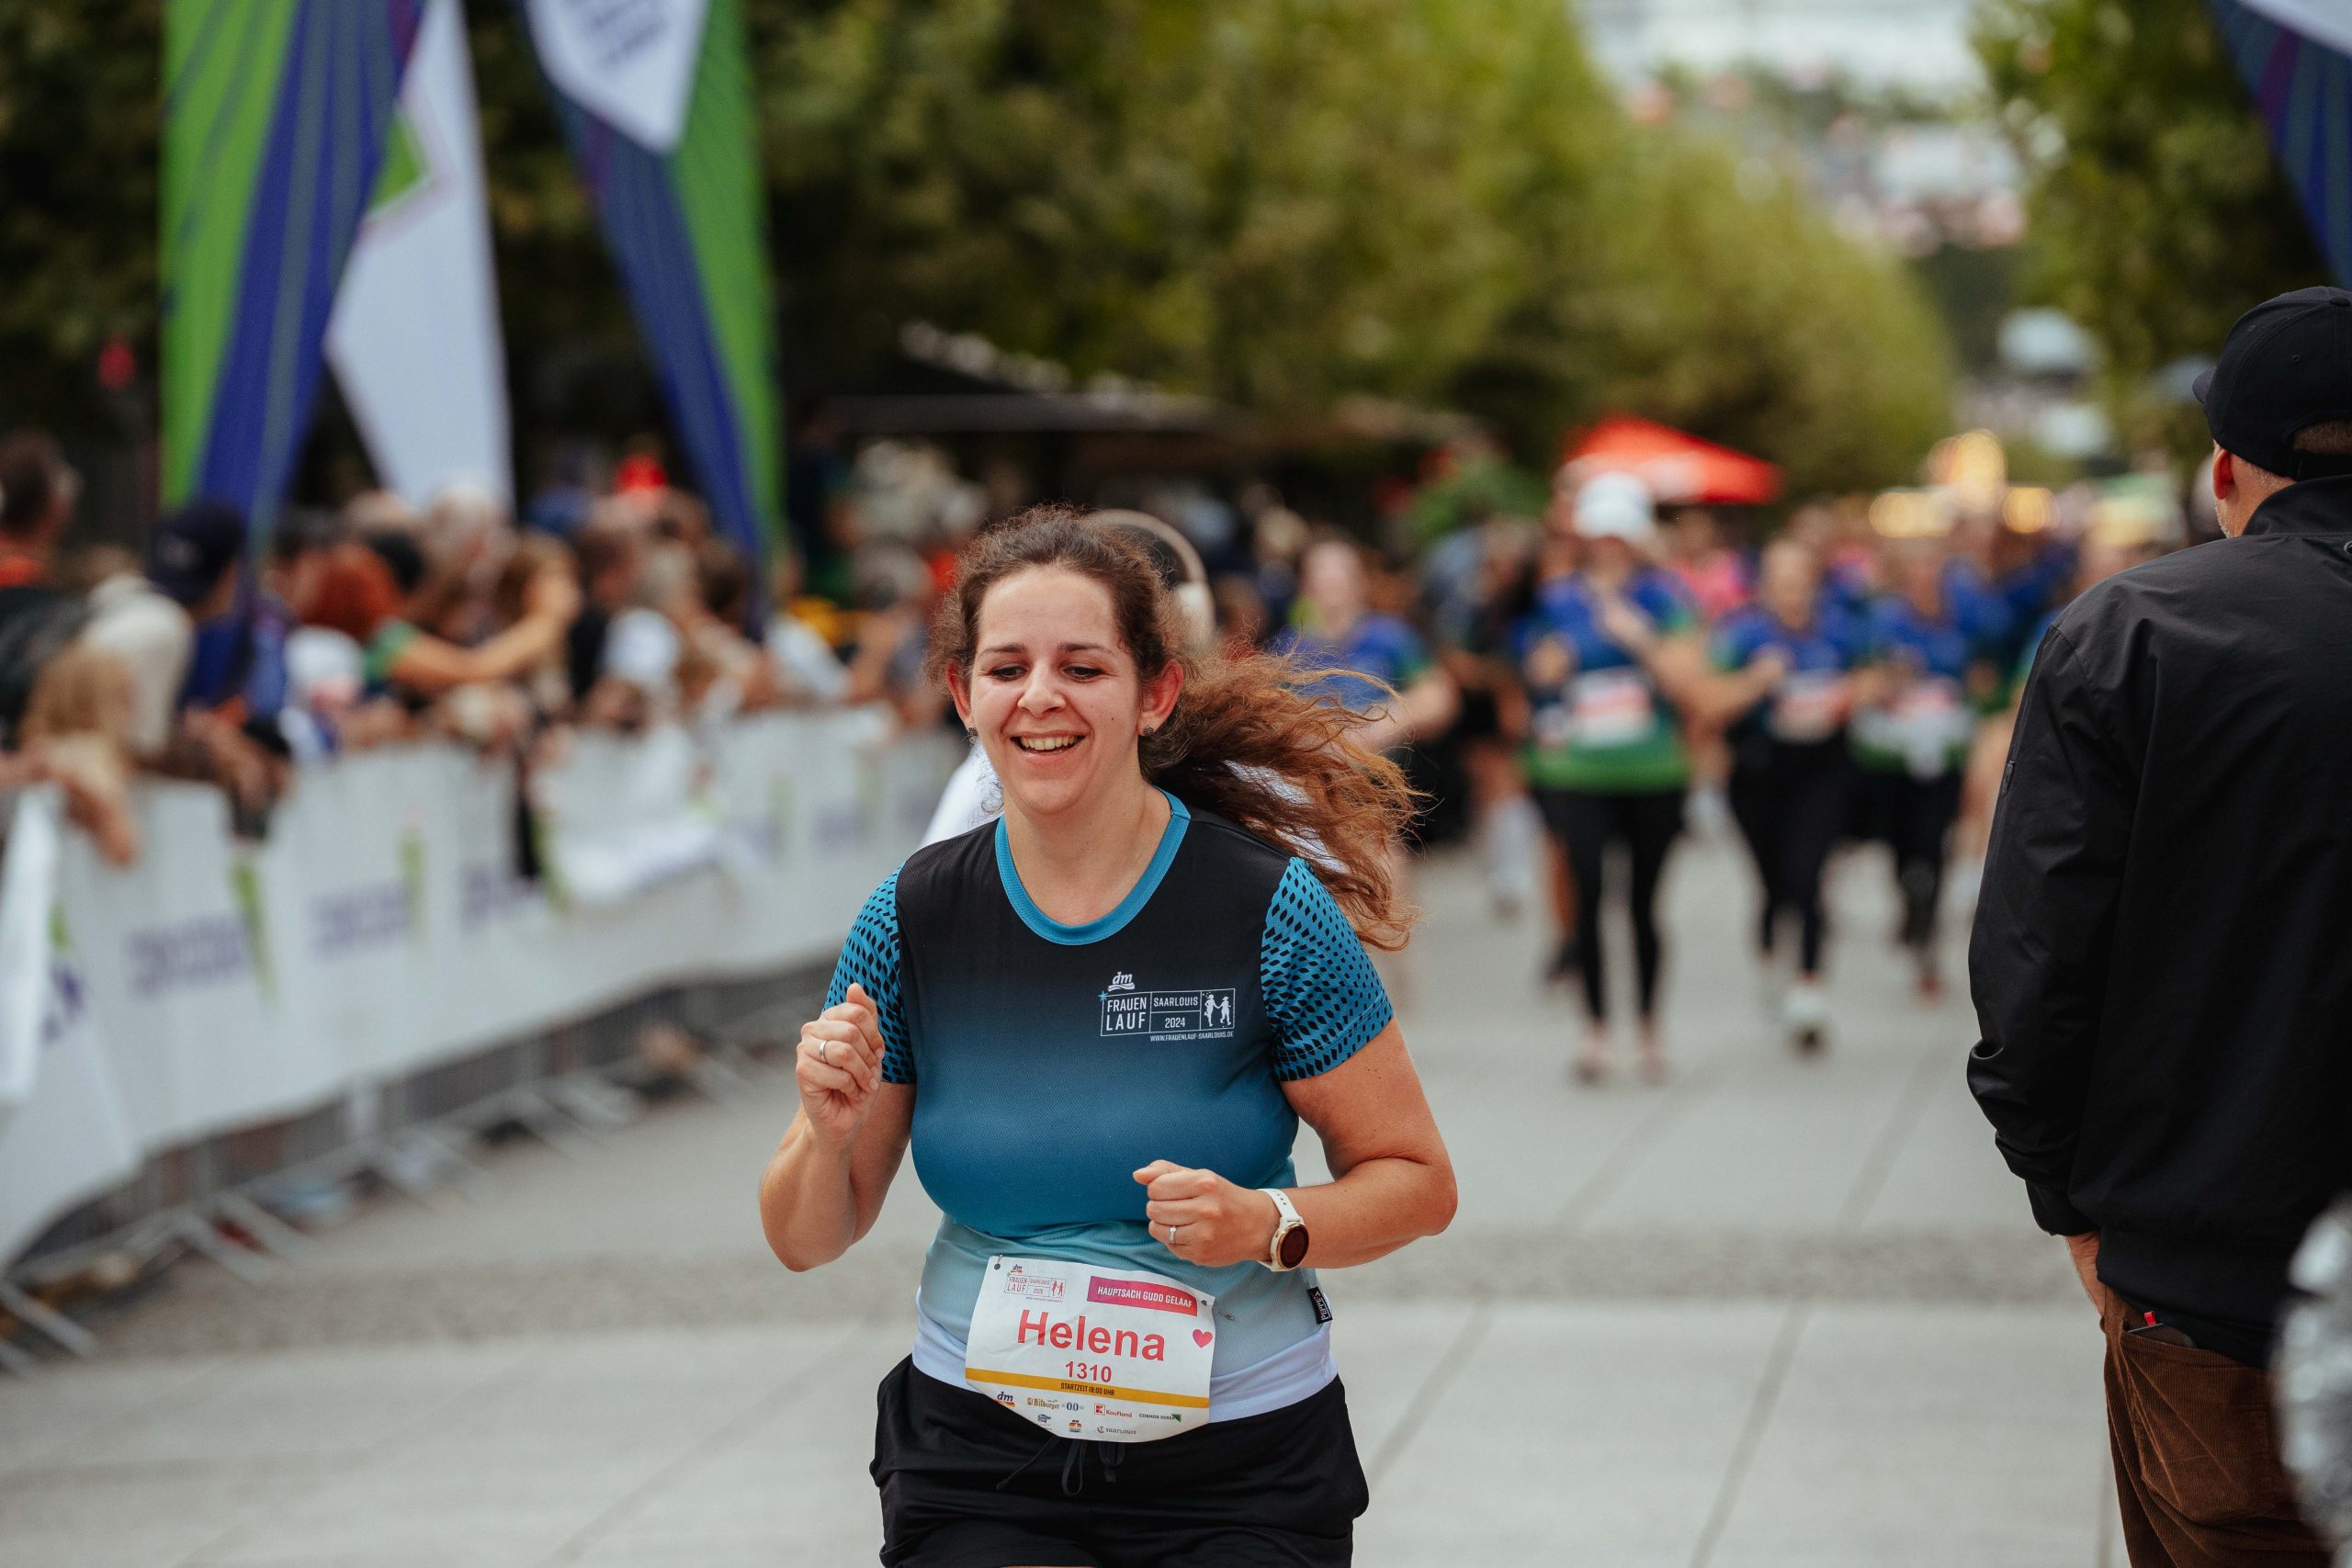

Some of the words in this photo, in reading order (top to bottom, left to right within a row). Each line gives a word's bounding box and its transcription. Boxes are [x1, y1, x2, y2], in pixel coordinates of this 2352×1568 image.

[1113, 972, 1133, 985] dm
[1107, 997, 1148, 1012] FRAUEN
[1153, 996, 1198, 1007] SAARLOUIS
[1105, 1012, 1146, 1031] LAUF
[1165, 1017, 1185, 1028] 2024
[1150, 1031, 1234, 1042] WWW.FRAUENLAUF-SAARLOUIS.DE
[1009, 1276, 1027, 1284] FRAUEN
[1007, 1284, 1025, 1292] LAUF
[1097, 1286, 1141, 1299] HAUPTSACH
[1143, 1292, 1163, 1303] GUDD
[1165, 1296, 1193, 1308] GELAAF
[1017, 1309, 1165, 1361] Helena
[1066, 1361, 1112, 1382] 1310
[1060, 1382, 1088, 1393] STARTZEIT
[1089, 1386, 1102, 1394] 18:00
[1103, 1388, 1114, 1396] UHR
[997, 1392, 1013, 1402] dm
[1034, 1398, 1060, 1410] Bitburger
[1106, 1409, 1132, 1417] Kaufland
